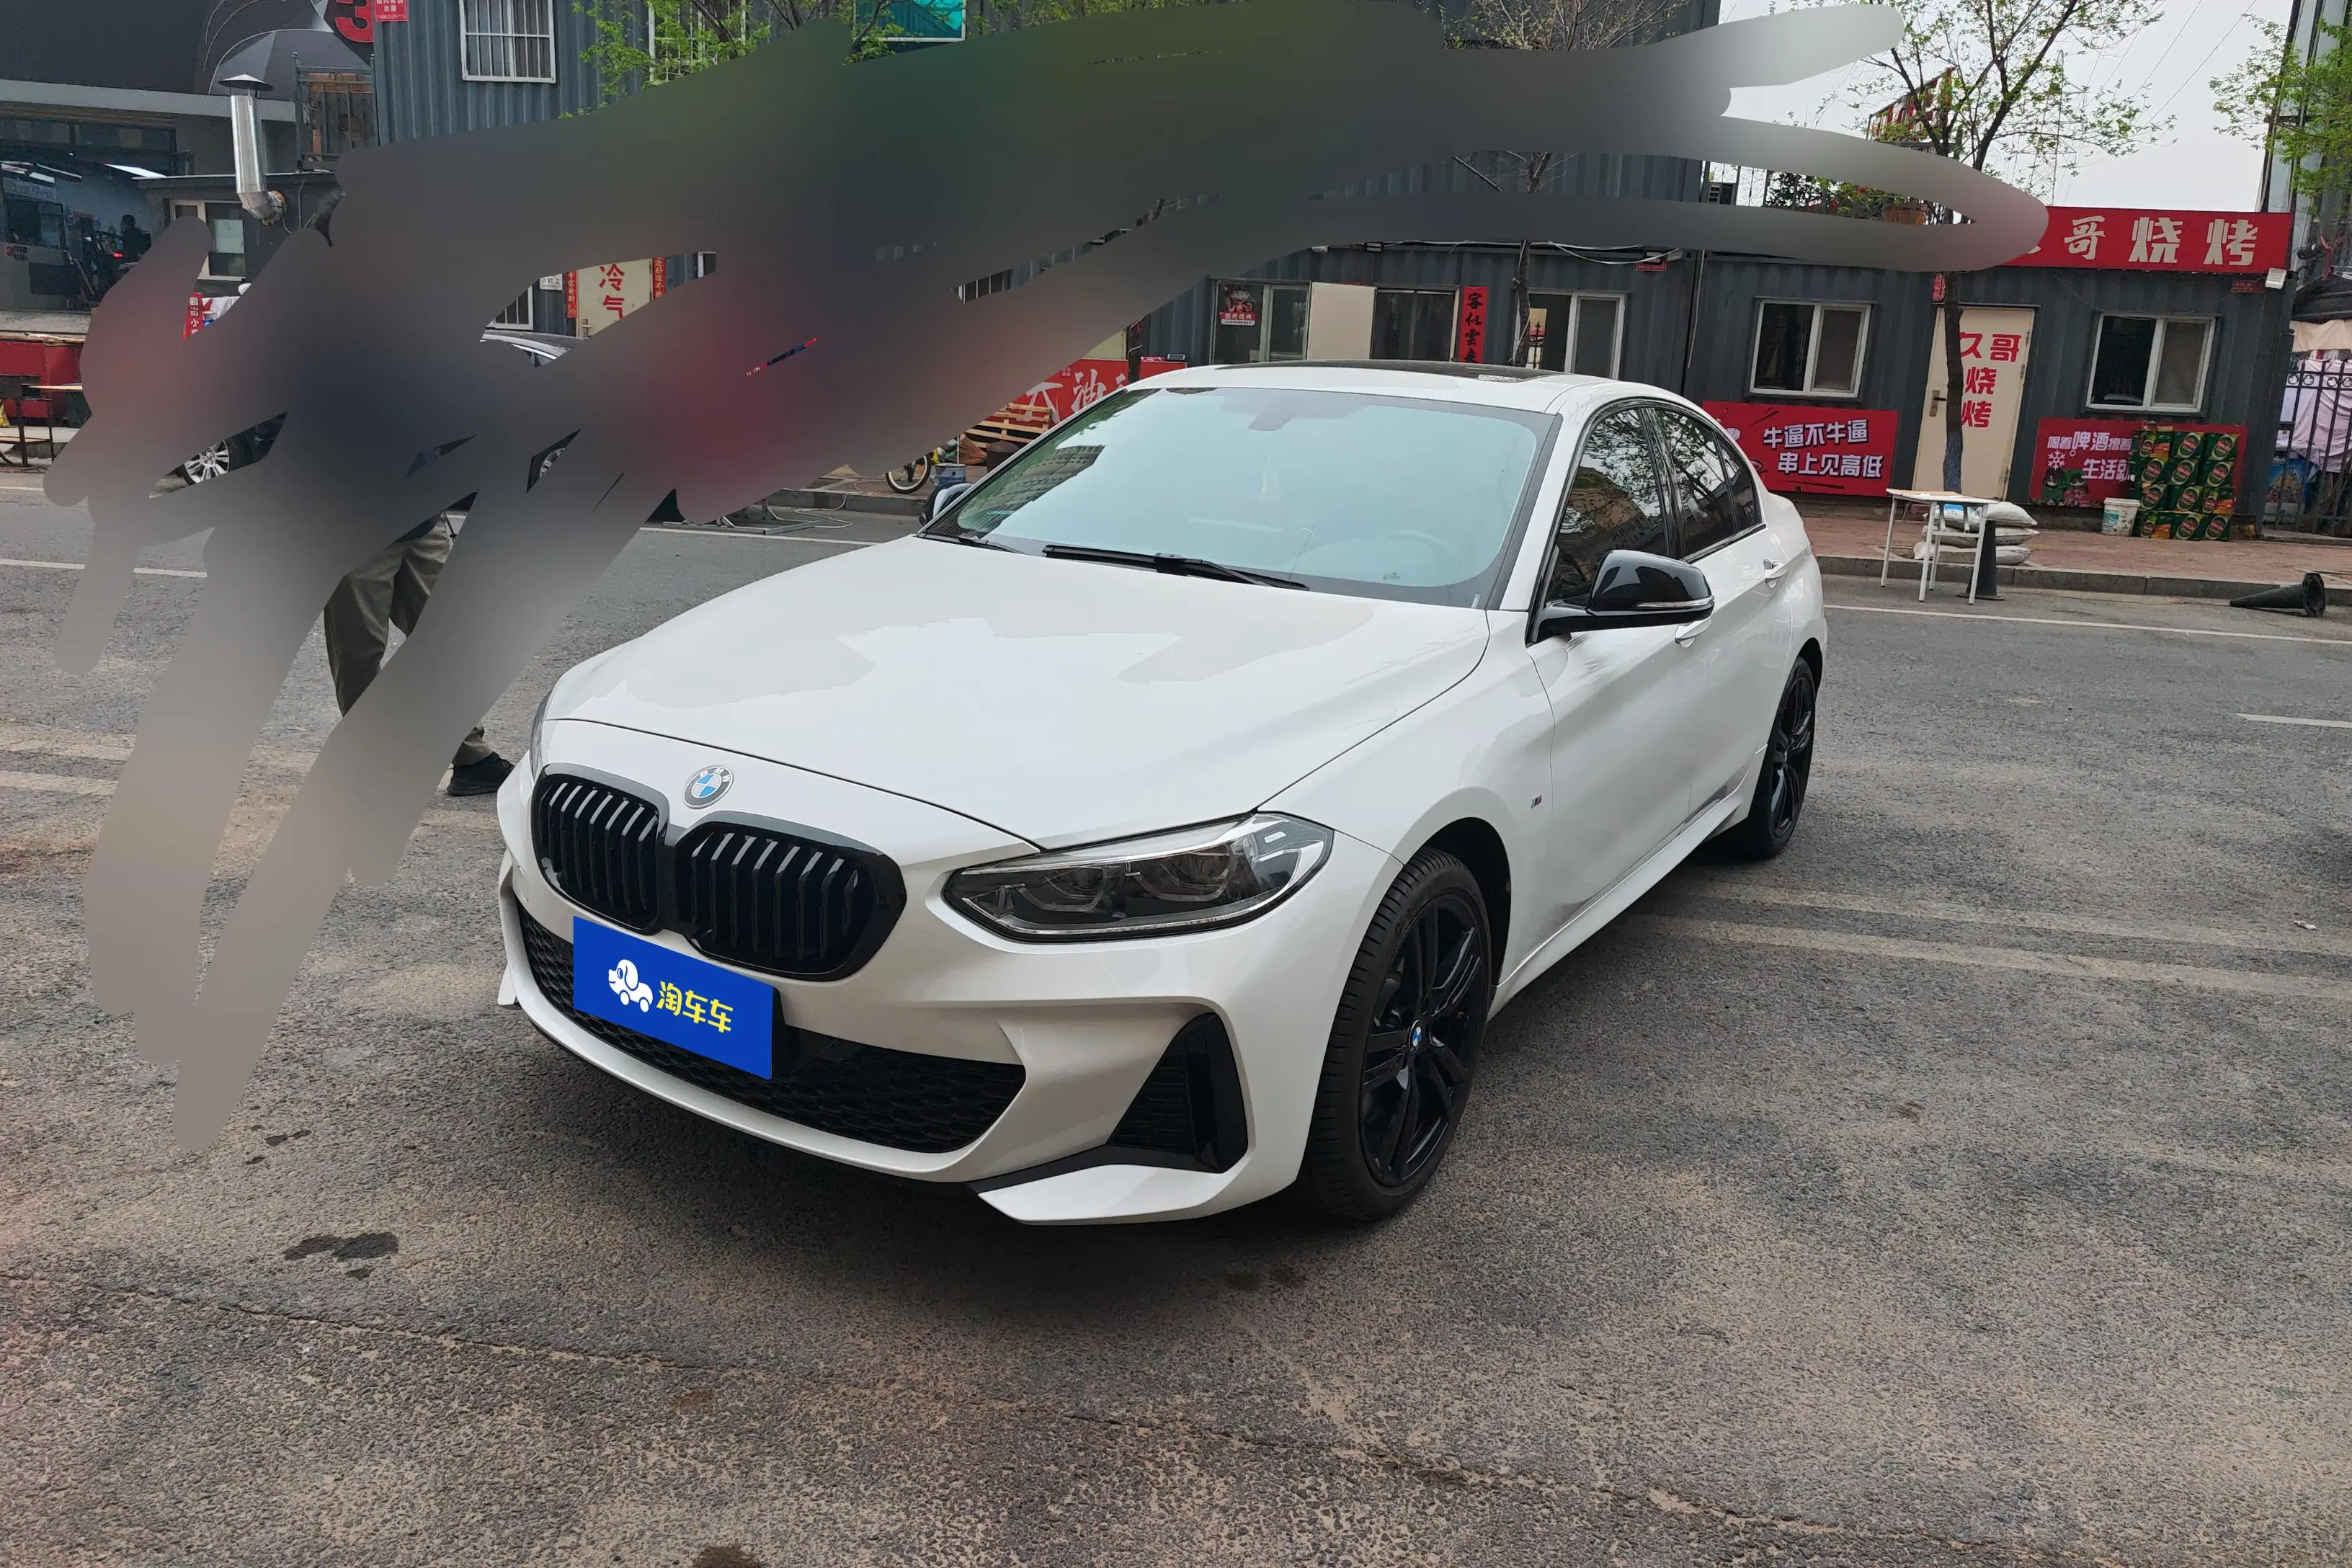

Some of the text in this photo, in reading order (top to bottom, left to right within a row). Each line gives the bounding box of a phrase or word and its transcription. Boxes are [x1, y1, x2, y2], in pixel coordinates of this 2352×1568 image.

[2028, 215, 2258, 266] 哥烧烤
[1763, 419, 1868, 450] 牛逼不牛逼
[1777, 451, 1884, 478] 串上见高低
